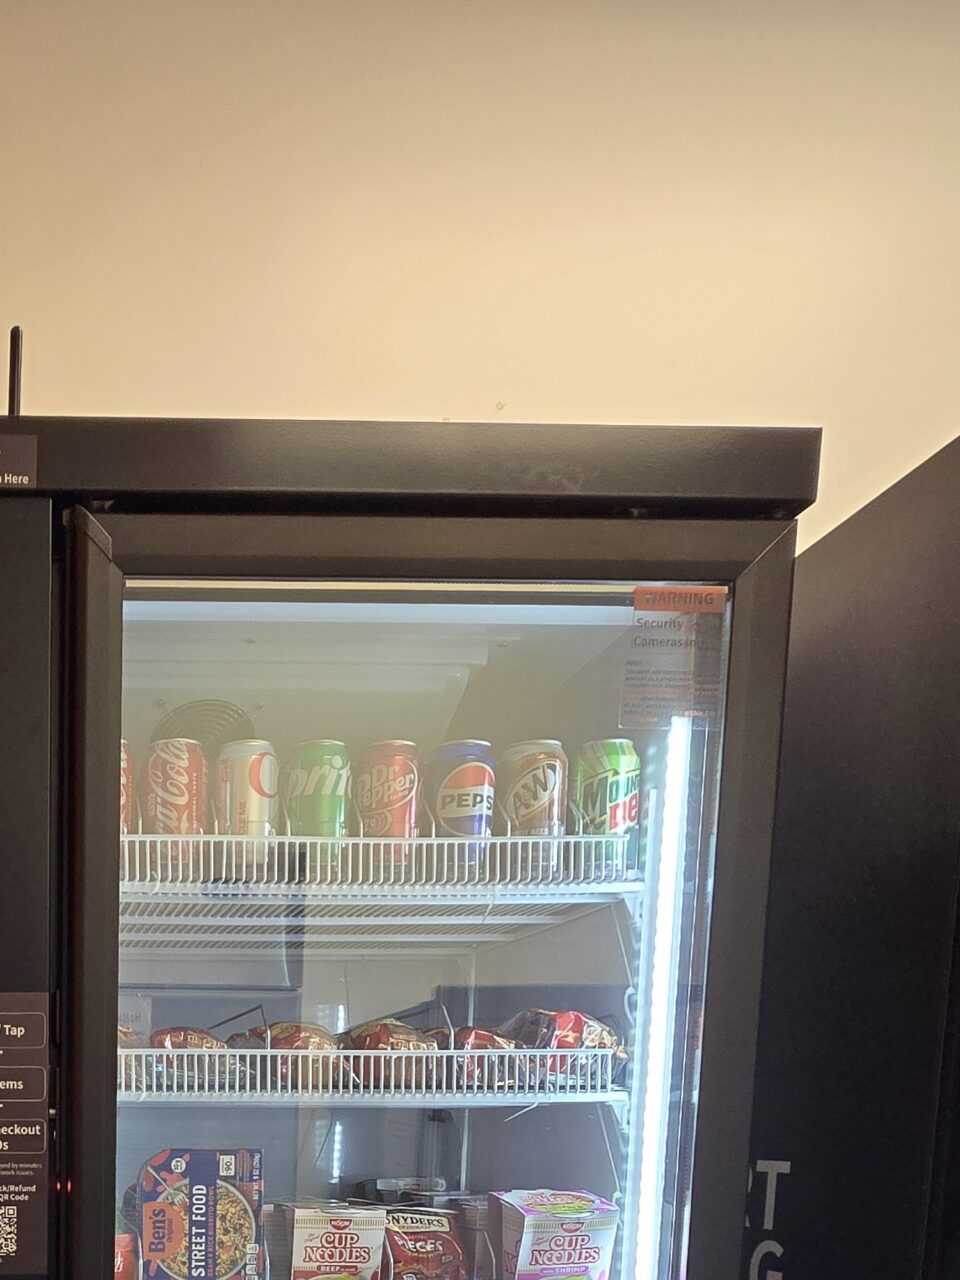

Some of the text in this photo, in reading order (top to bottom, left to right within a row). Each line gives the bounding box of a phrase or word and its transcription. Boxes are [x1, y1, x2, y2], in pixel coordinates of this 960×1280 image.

[4, 473, 29, 484] Here
[644, 592, 715, 605] WARNING
[636, 617, 685, 631] Security
[633, 636, 683, 648] Cameras
[371, 763, 400, 789] Dr
[354, 772, 415, 810] Pepper
[3, 1024, 25, 1038] Tap
[744, 1159, 792, 1231] T
[148, 1207, 167, 1253] Ben's
[191, 1184, 208, 1278] STREET FOOD
[320, 1232, 359, 1248] CUP
[549, 1234, 591, 1250] CUP
[303, 1247, 370, 1263] NOODLES
[529, 1248, 600, 1266] NOODLES
